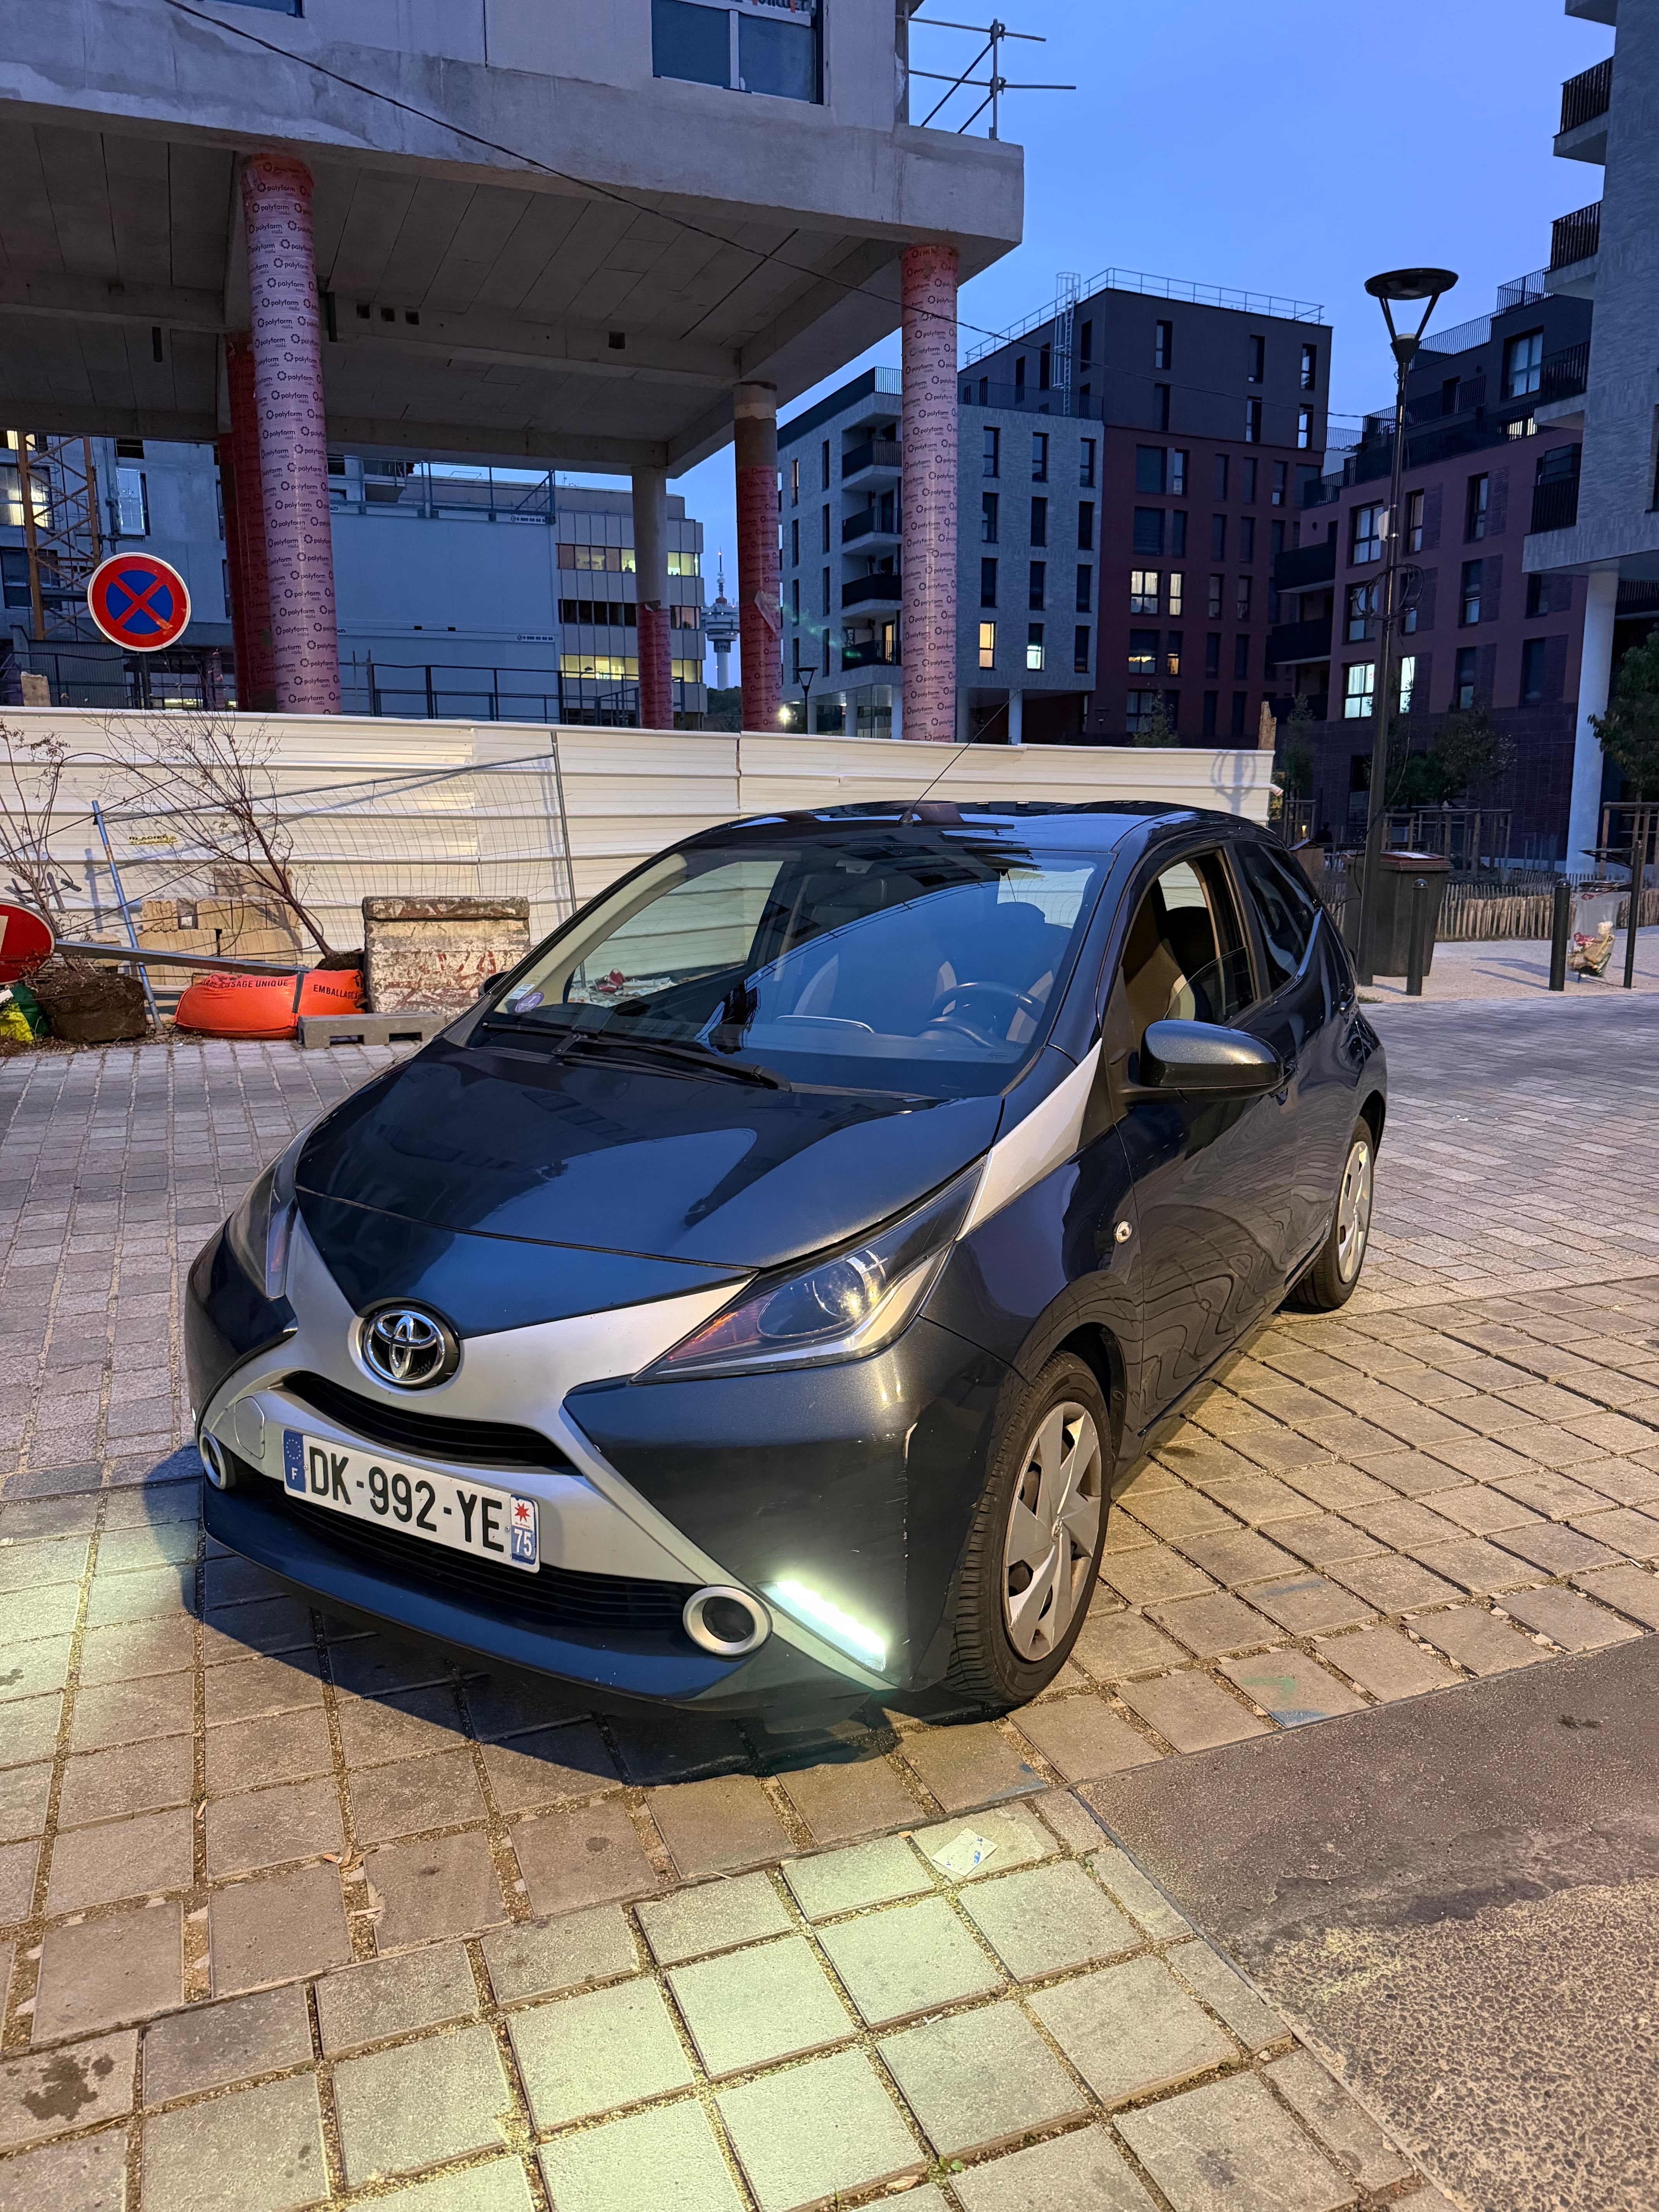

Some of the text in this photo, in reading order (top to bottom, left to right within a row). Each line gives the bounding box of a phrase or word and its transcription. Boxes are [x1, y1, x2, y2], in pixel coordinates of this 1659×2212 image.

[256, 223, 282, 232] polyform
[265, 318, 292, 326] polyform
[261, 337, 285, 347] polyform
[275, 410, 302, 419] polyform
[270, 429, 295, 438] polyform
[264, 448, 289, 457] polyform
[270, 557, 292, 565] polyform
[313, 984, 354, 999] EMBALLAGE
[292, 1446, 532, 1556] F DK-992-YE 75
